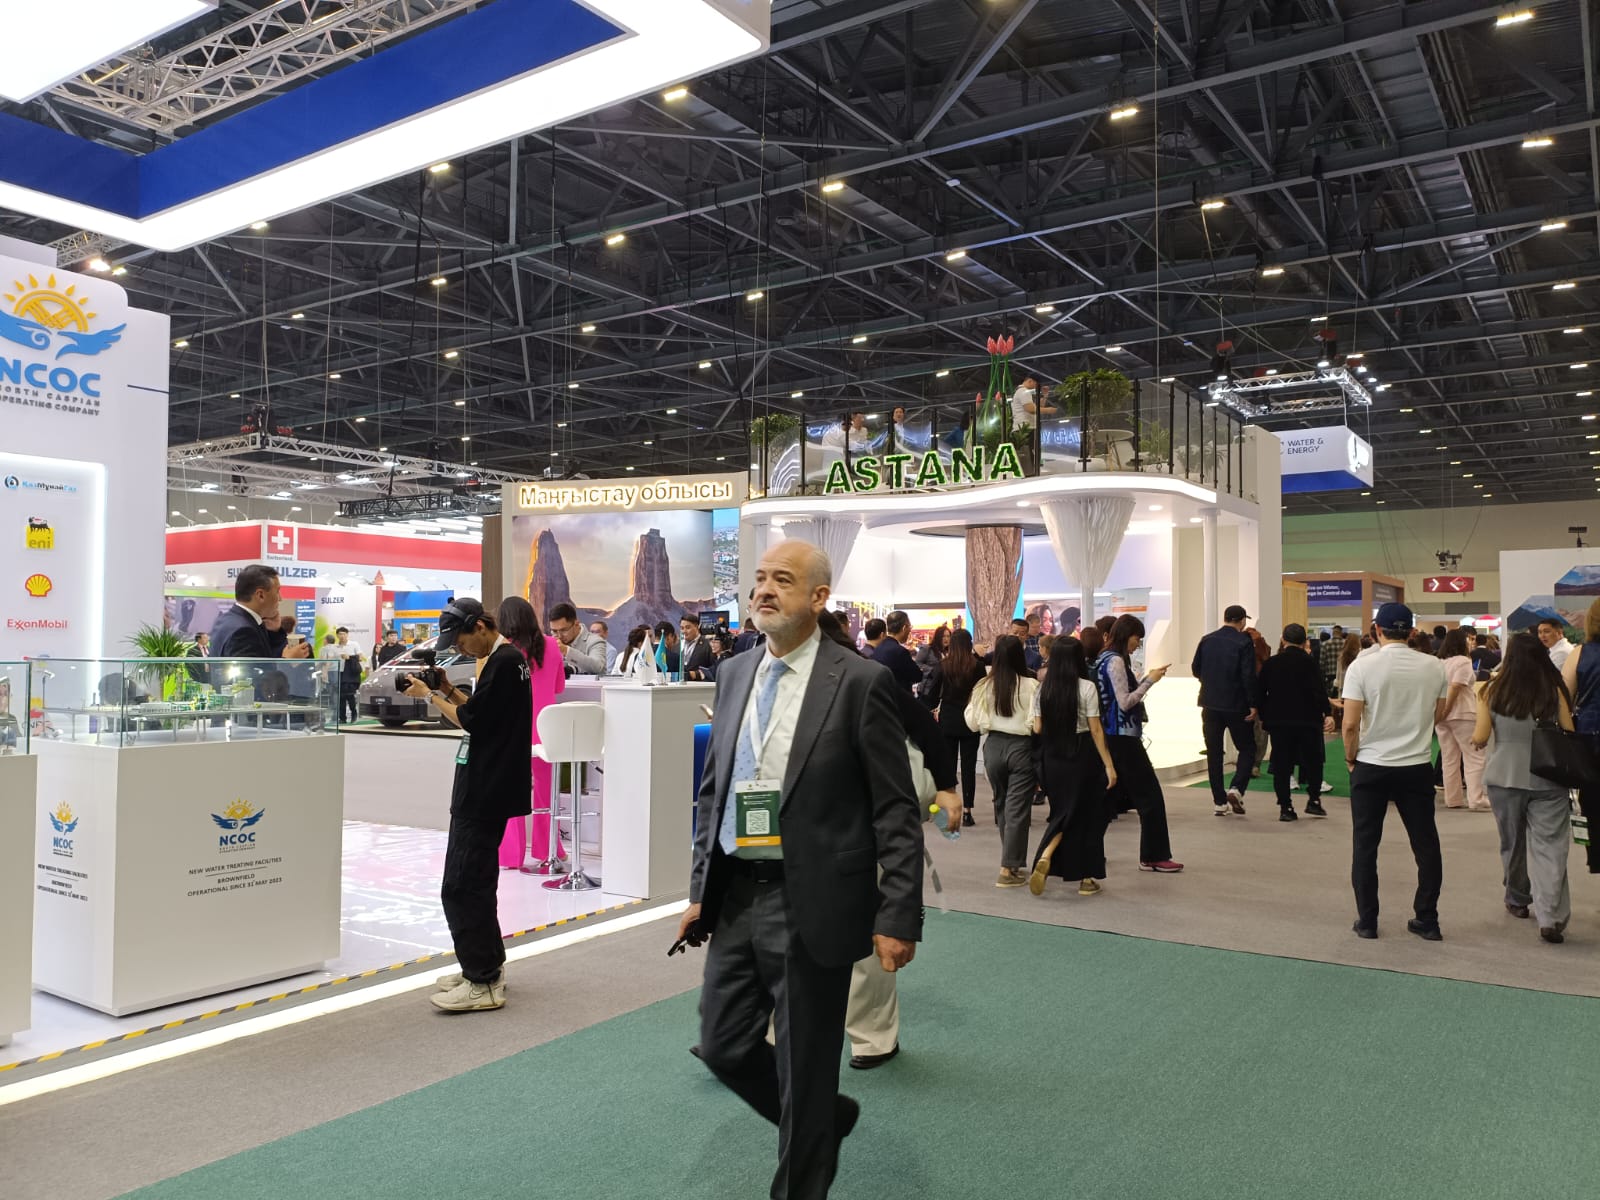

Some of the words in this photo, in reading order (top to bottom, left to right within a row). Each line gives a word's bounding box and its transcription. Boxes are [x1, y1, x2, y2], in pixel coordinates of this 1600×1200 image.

[0, 356, 101, 398] NCOC
[46, 392, 100, 407] CASPIAN
[54, 403, 100, 416] COMPANY
[1287, 438, 1315, 447] WATER
[1287, 446, 1320, 455] ENERGY
[823, 442, 1025, 495] ASTANA
[519, 485, 636, 507] Маңғыстау
[640, 481, 731, 500] облысы
[28, 536, 51, 549] eni
[276, 566, 317, 578] ULZER
[7, 618, 68, 631] ExxonMobil
[53, 837, 73, 850] NCOC
[219, 832, 256, 846] NCOC
[226, 861, 254, 869] TREATING
[217, 873, 255, 884] BROWNFIELD
[187, 886, 228, 897] OPERATIONAL
